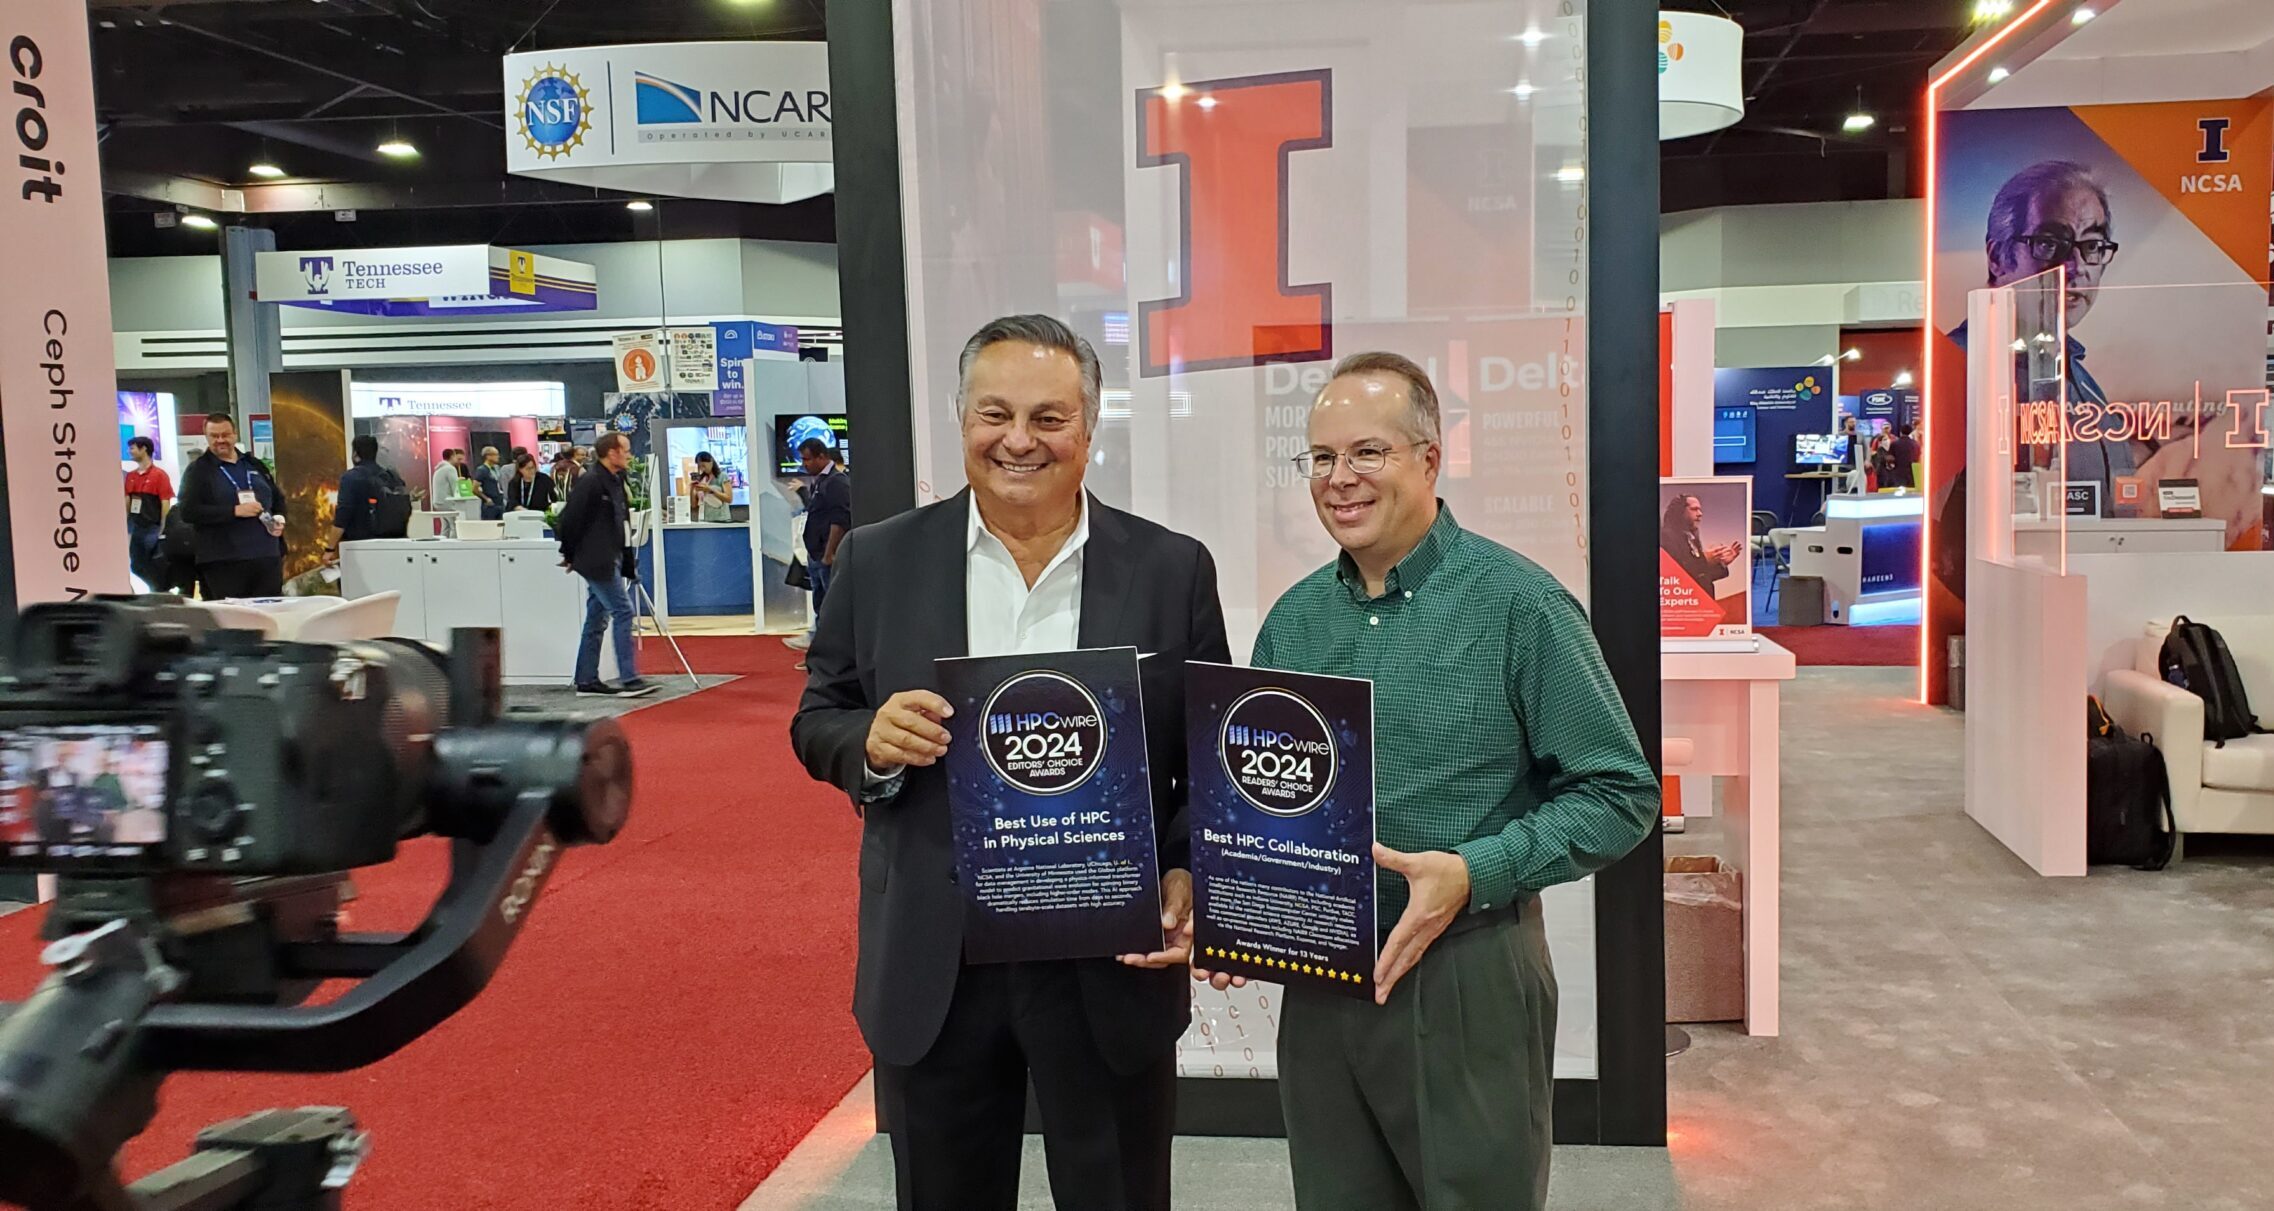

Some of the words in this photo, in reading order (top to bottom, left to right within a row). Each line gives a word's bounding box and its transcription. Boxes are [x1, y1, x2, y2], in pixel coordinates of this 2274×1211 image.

[527, 97, 578, 126] NSF
[711, 90, 832, 123] NCAR
[9, 35, 65, 203] croit
[647, 130, 732, 142] Operated
[747, 131, 765, 141] by
[781, 131, 826, 139] UCAR
[2181, 175, 2242, 194] NCSA
[342, 260, 443, 277] Tennessee
[346, 278, 386, 289] TECH
[40, 310, 74, 409] Ceph
[720, 357, 744, 369] Spin
[727, 371, 738, 379] to
[722, 380, 744, 389] win.
[407, 399, 472, 410] Tennessee
[52, 422, 80, 575] Storage
[1659, 575, 1680, 585] Talk
[1659, 587, 1671, 595] To
[1673, 586, 1694, 595] Our
[1659, 597, 1699, 607] Experts
[1004, 732, 1082, 760] 2024
[1007, 761, 1045, 770] EDITORS'
[1047, 758, 1083, 768] CHOICE
[1029, 767, 1065, 777] AWARDS
[1241, 749, 1313, 782] 2024
[1242, 776, 1278, 788] READERS'
[1280, 781, 1313, 793] CHOICE
[1262, 788, 1296, 799] AWARDS
[995, 817, 1026, 830] Best
[1030, 815, 1057, 827] Use
[1061, 812, 1076, 825] of
[1080, 811, 1111, 824] HPC
[984, 836, 997, 849] in
[1001, 831, 1059, 850] Physical
[1064, 831, 1126, 844] Sciences
[1203, 828, 1233, 845] Best
[1236, 833, 1265, 849] HPC
[1268, 838, 1360, 864] Collaboration
[1221, 848, 1341, 875] (Academia/Government/Industry)
[1236, 939, 1261, 949] Awards
[1262, 943, 1286, 955] Winner
[1288, 947, 1298, 955] for
[1300, 949, 1307, 958] 13
[1309, 951, 1329, 962] Years
